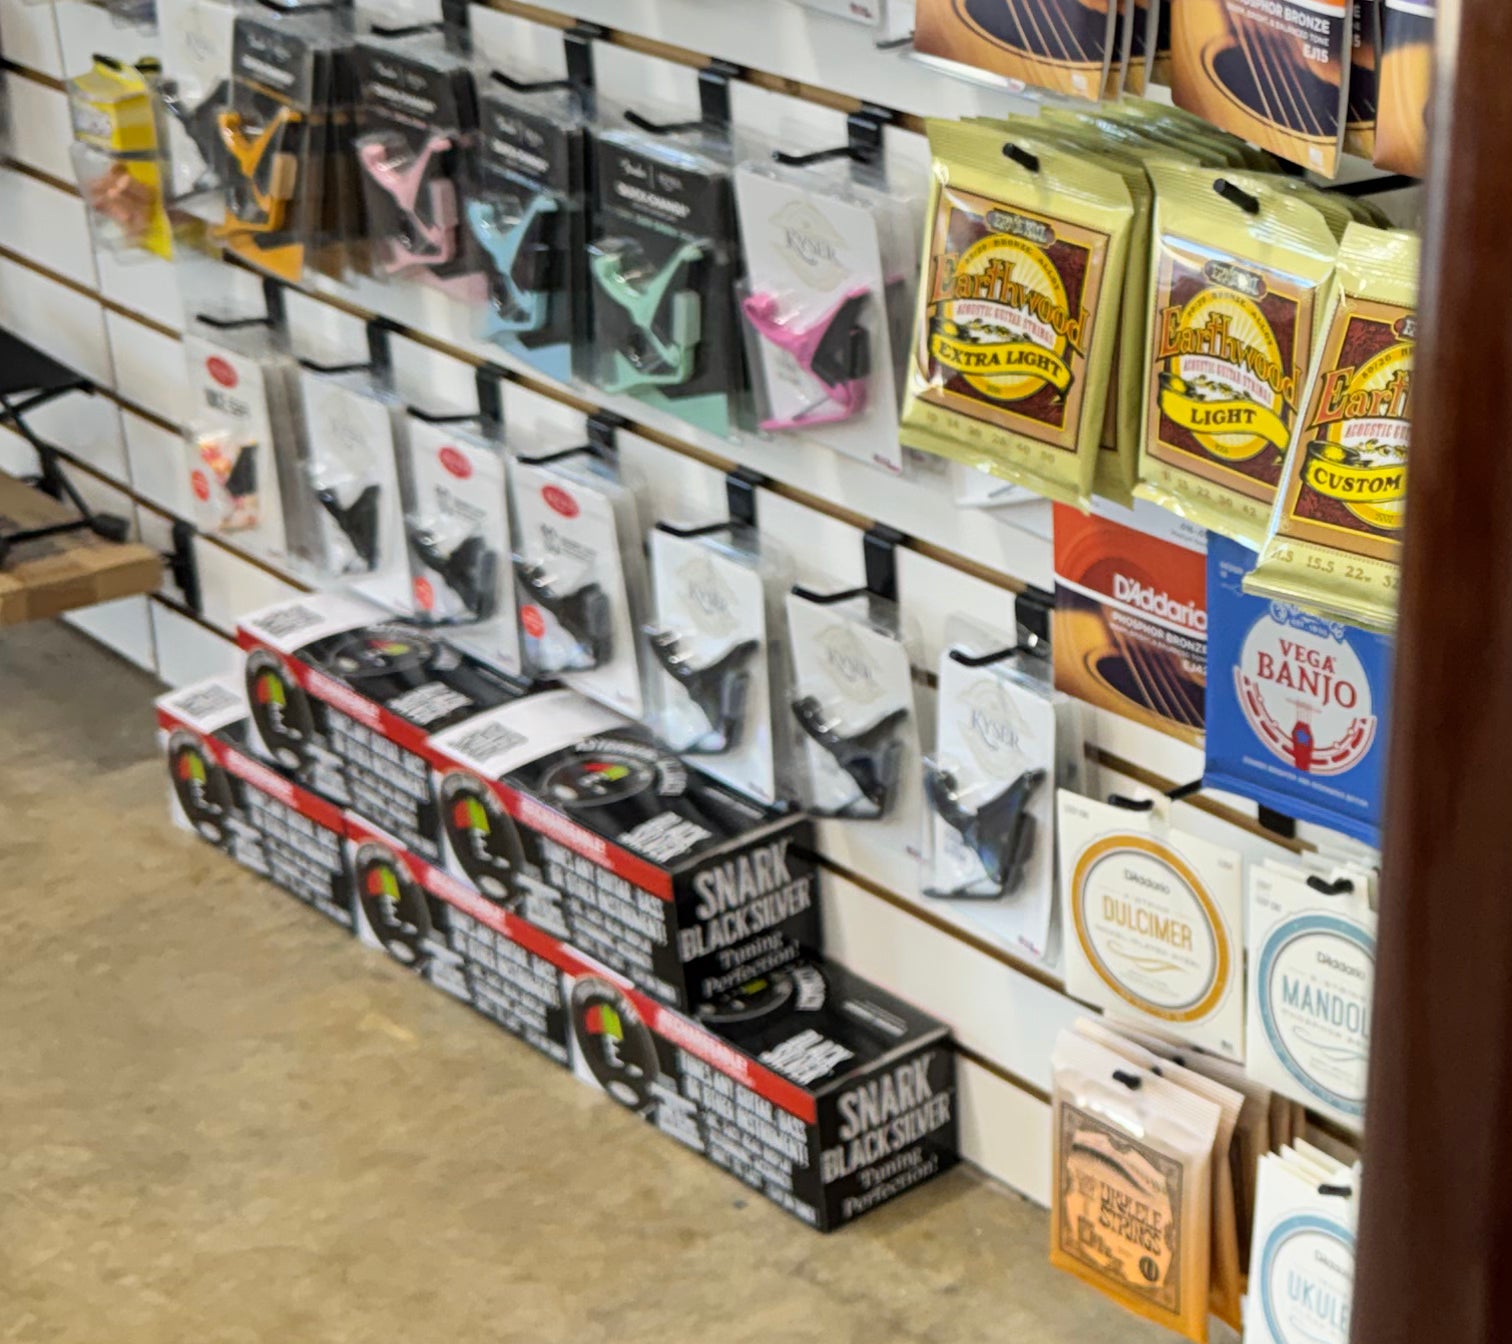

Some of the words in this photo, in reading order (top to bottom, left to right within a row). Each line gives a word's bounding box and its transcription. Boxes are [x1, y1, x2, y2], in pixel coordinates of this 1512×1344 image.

[1303, 44, 1329, 63] EJ15
[928, 252, 1090, 359] Earthwood
[1155, 305, 1303, 416] Earthwood
[1190, 408, 1257, 426] LIGHT
[1313, 468, 1402, 494] CUSTOM
[1256, 651, 1358, 709] BANJO
[1279, 637, 1337, 674] VEGA
[693, 842, 791, 921] SNARK
[1102, 895, 1193, 952] DULCIMER
[1282, 973, 1369, 1038] MANDOL
[837, 1056, 934, 1142] SNARK
